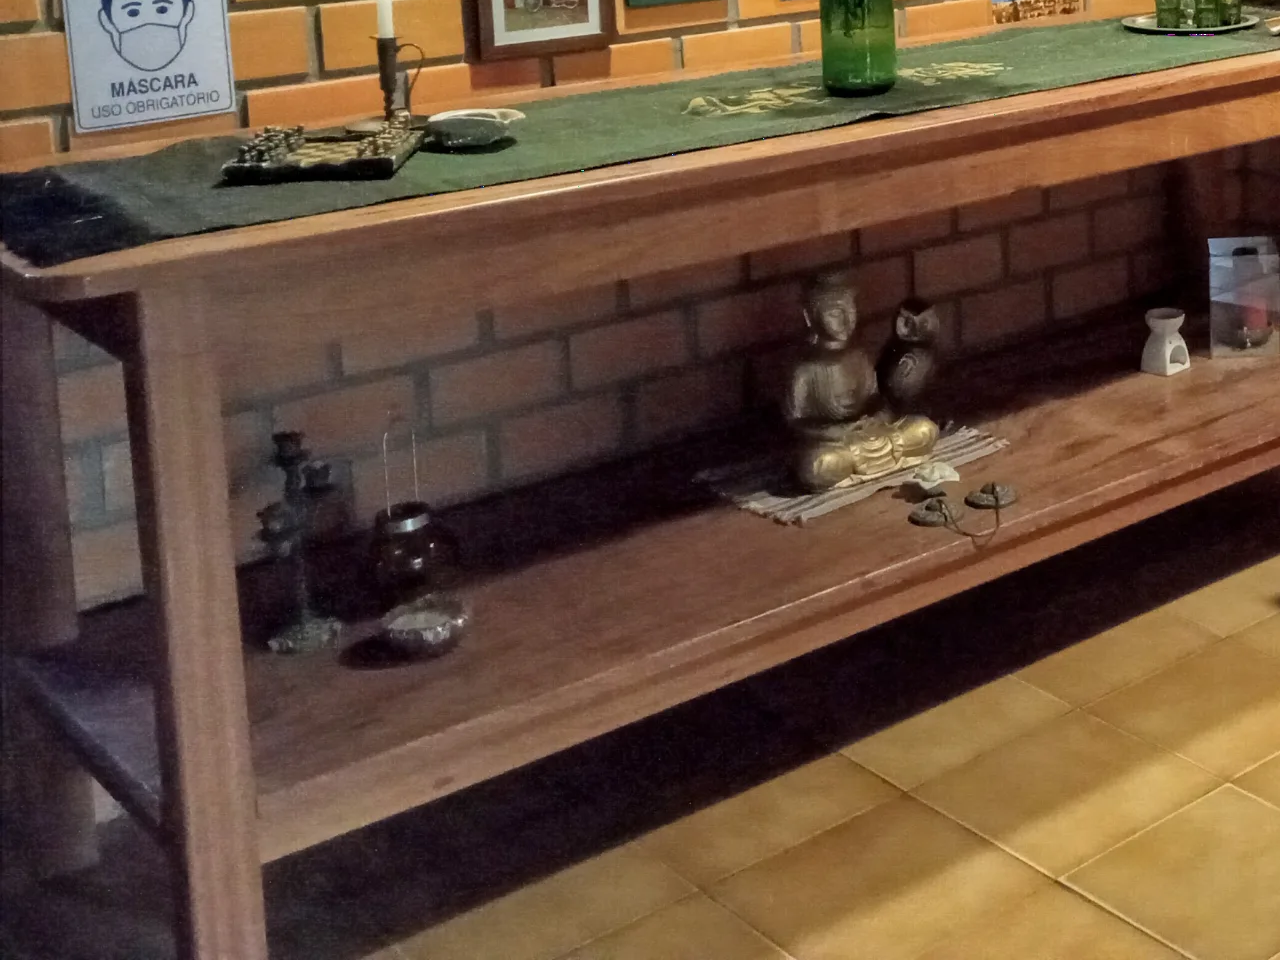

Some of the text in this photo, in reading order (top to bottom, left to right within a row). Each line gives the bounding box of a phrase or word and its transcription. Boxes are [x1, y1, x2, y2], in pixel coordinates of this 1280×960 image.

[110, 72, 198, 98] MÁSCARA
[91, 90, 220, 119] USO OBRIGATÓRIO
